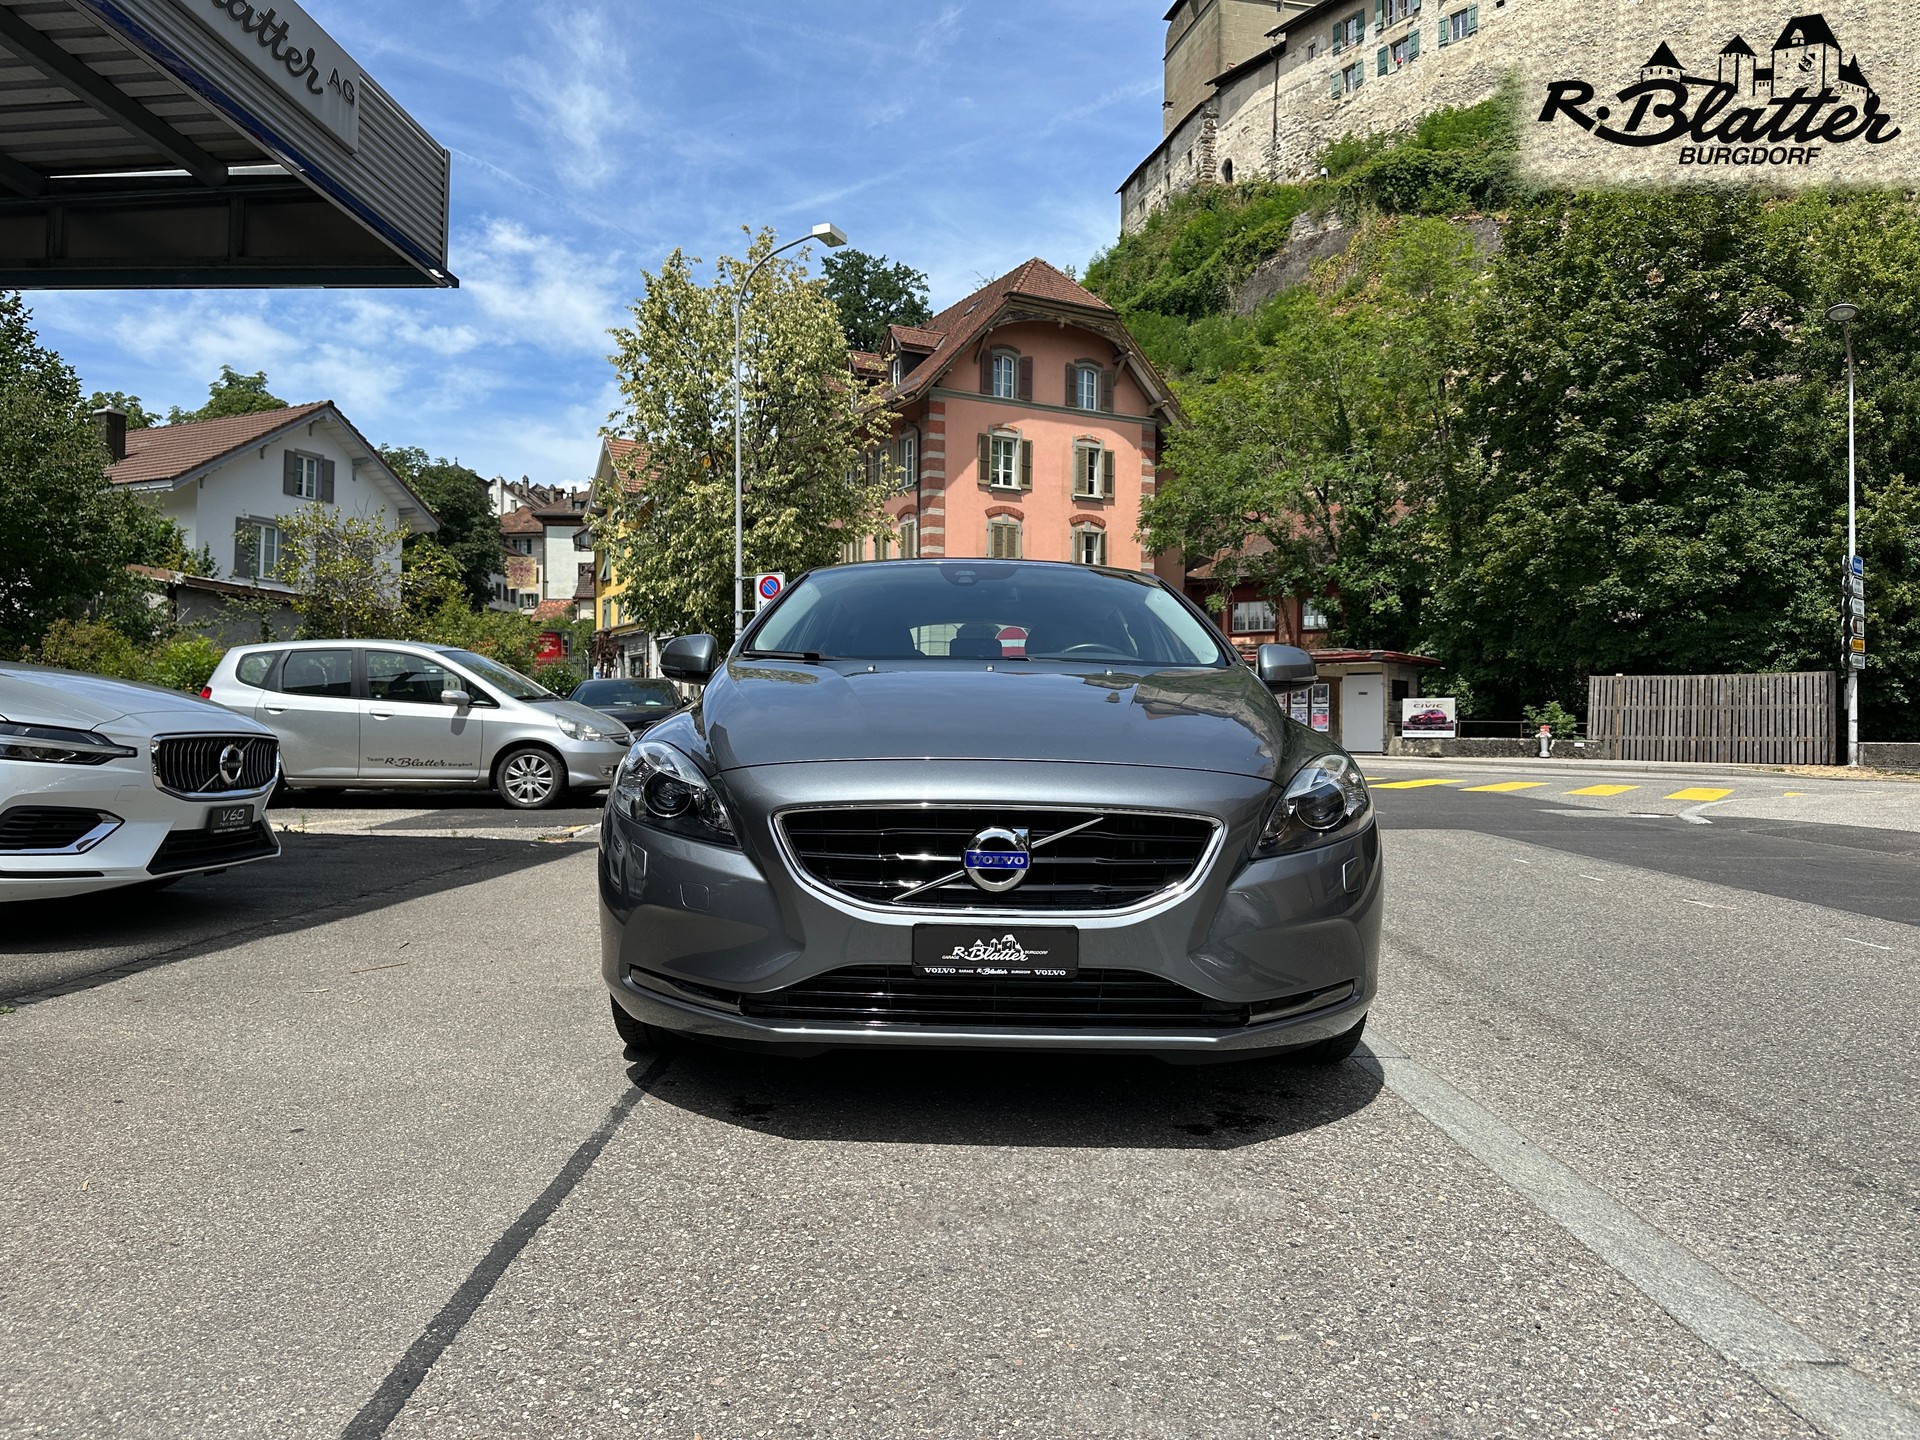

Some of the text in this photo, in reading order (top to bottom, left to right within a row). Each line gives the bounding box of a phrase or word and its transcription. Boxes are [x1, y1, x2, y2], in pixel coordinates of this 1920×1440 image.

[327, 67, 355, 106] AG
[222, 808, 245, 821] V60
[970, 855, 1025, 865] VOLVO
